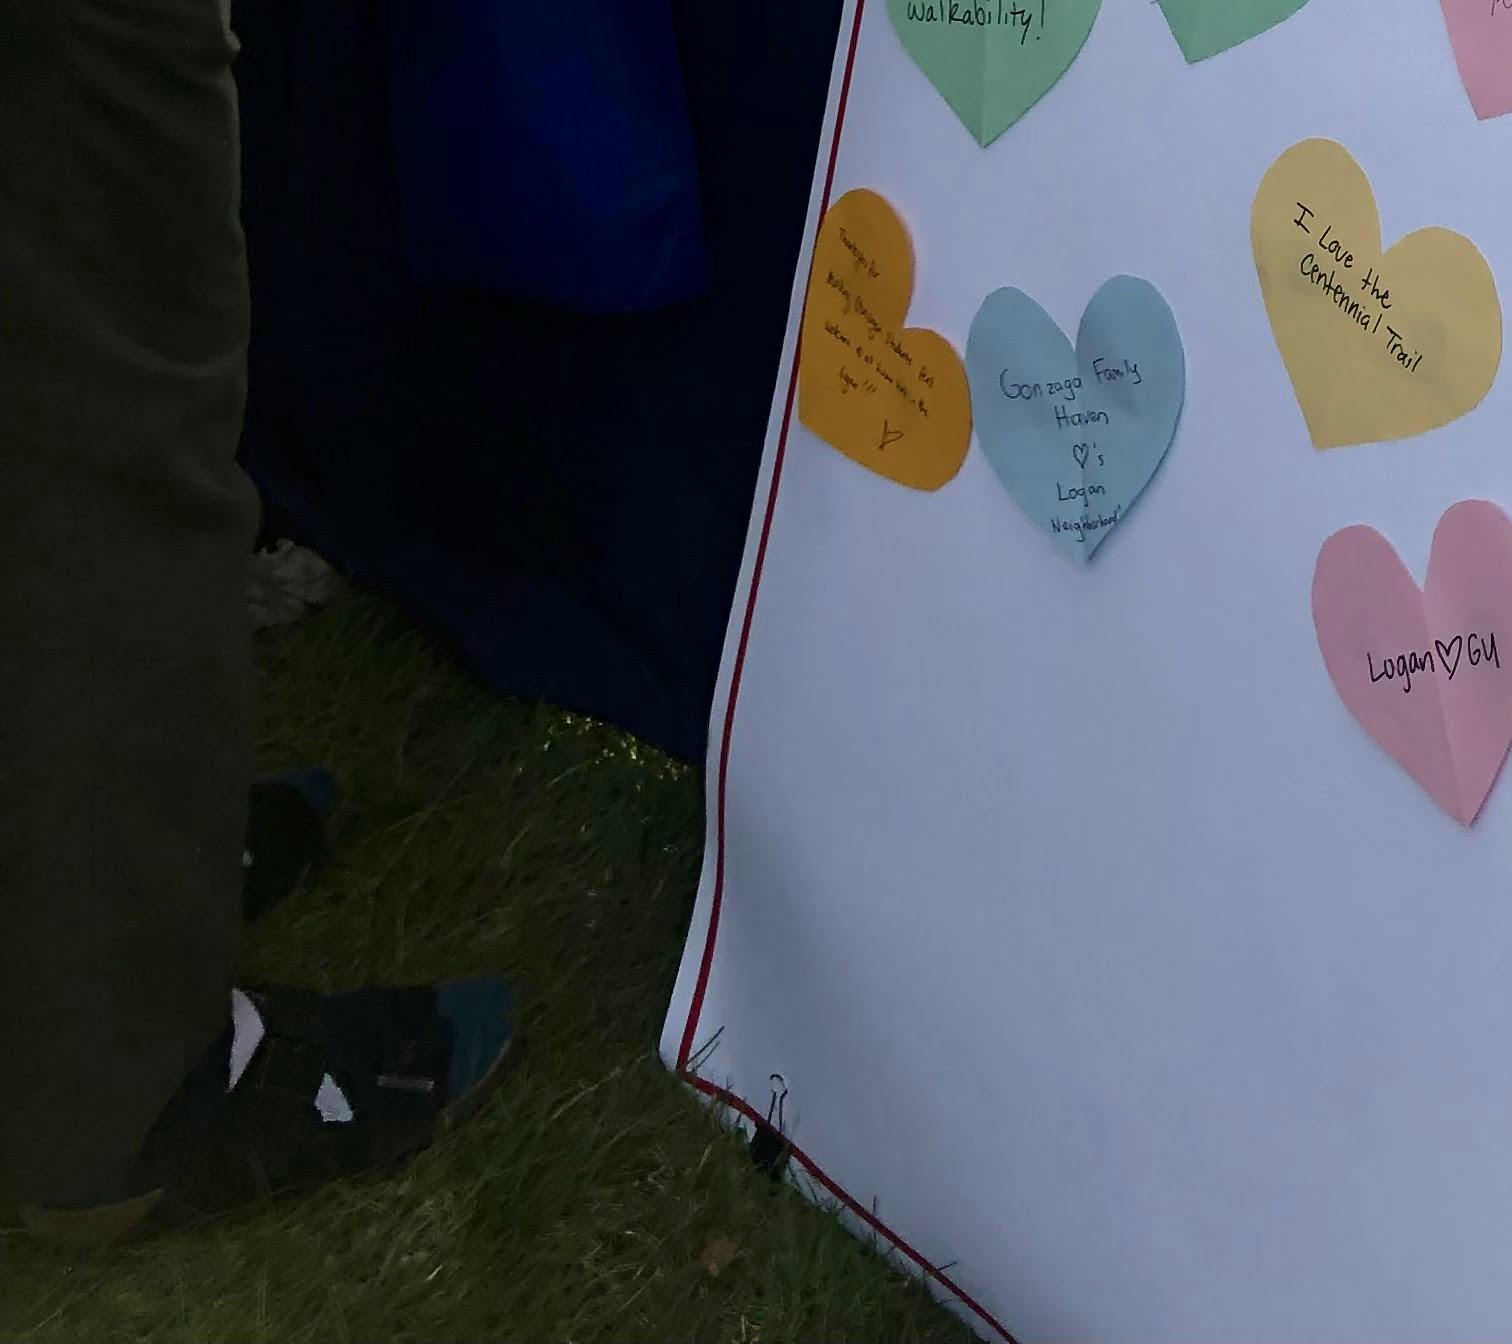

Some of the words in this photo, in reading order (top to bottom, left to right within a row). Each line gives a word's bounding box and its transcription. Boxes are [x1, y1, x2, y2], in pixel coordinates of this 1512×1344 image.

[1293, 201, 1315, 234] I
[1361, 267, 1392, 310] the
[1300, 253, 1383, 334] Centennial
[1386, 325, 1423, 373] Trail
[1054, 404, 1110, 431] Haven
[1056, 481, 1106, 508] Logan
[1366, 650, 1435, 694] Logan
